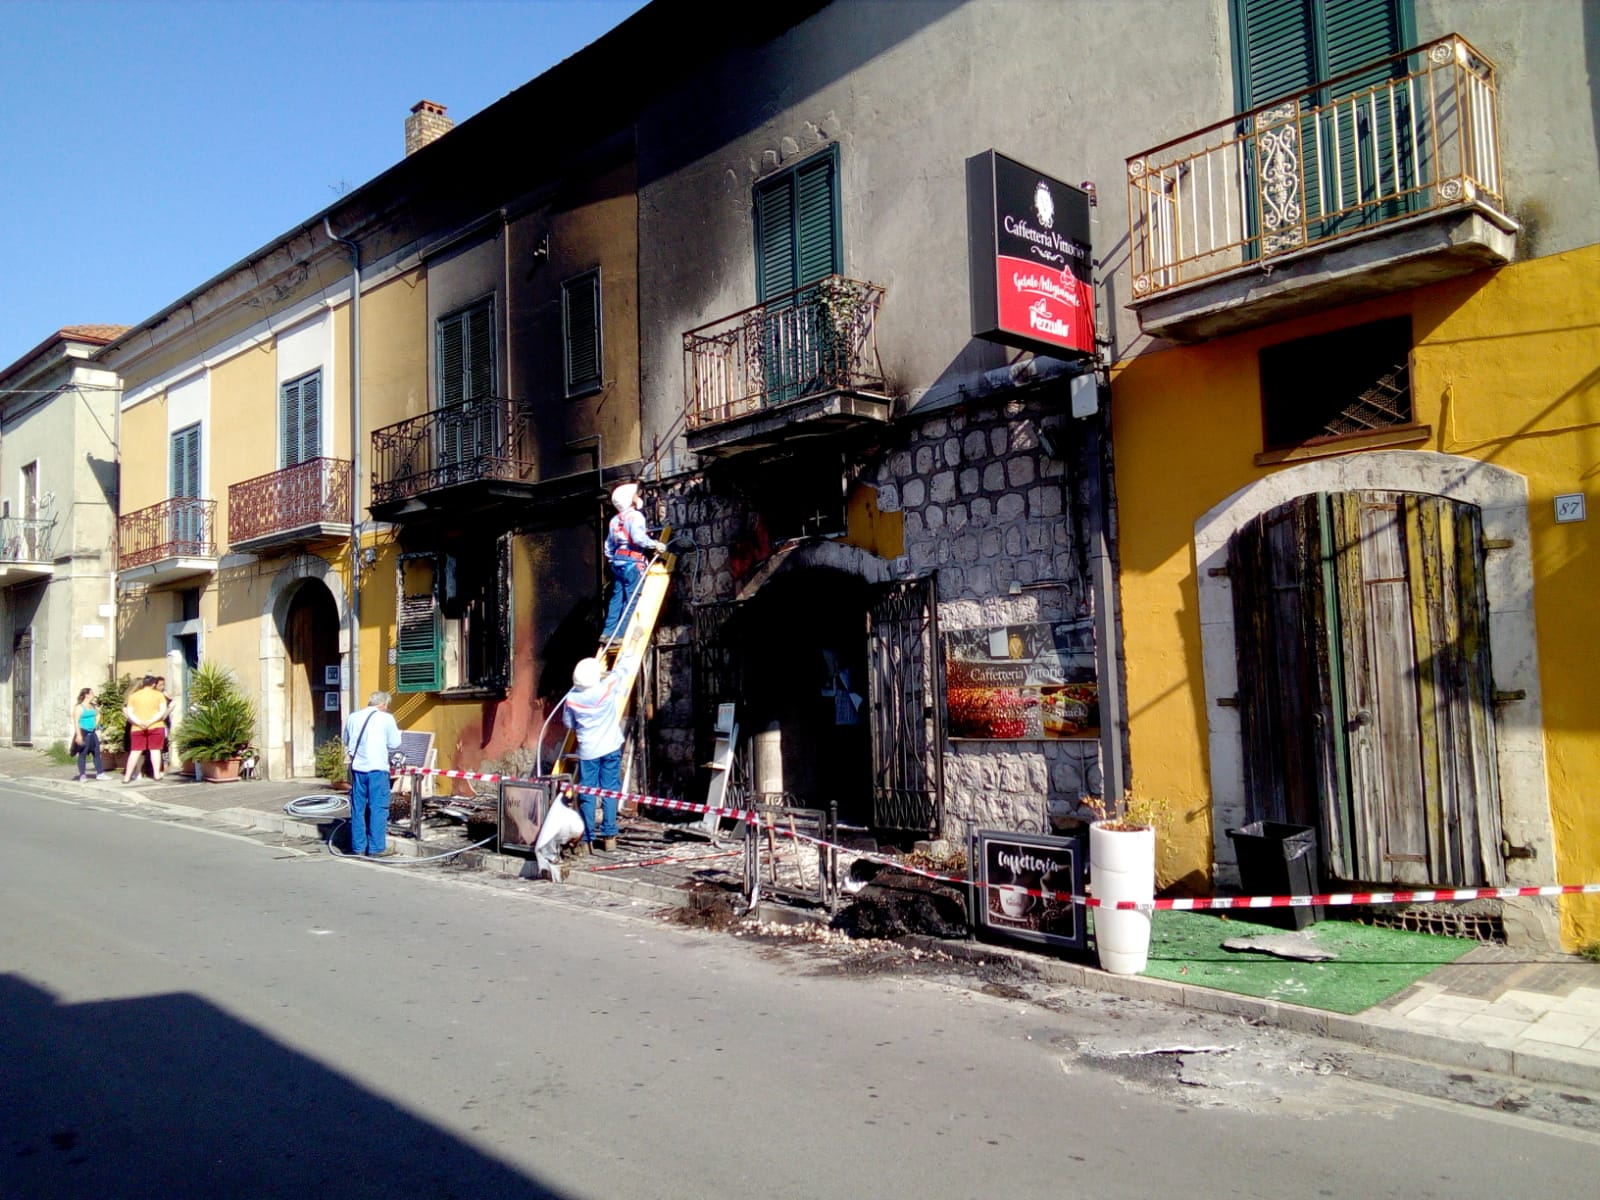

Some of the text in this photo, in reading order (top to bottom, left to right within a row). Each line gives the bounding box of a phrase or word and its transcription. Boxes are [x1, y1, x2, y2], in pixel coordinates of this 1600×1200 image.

[1004, 214, 1053, 249] Caffetteria
[1559, 502, 1580, 516] 87
[970, 667, 1024, 682] Caffetteria
